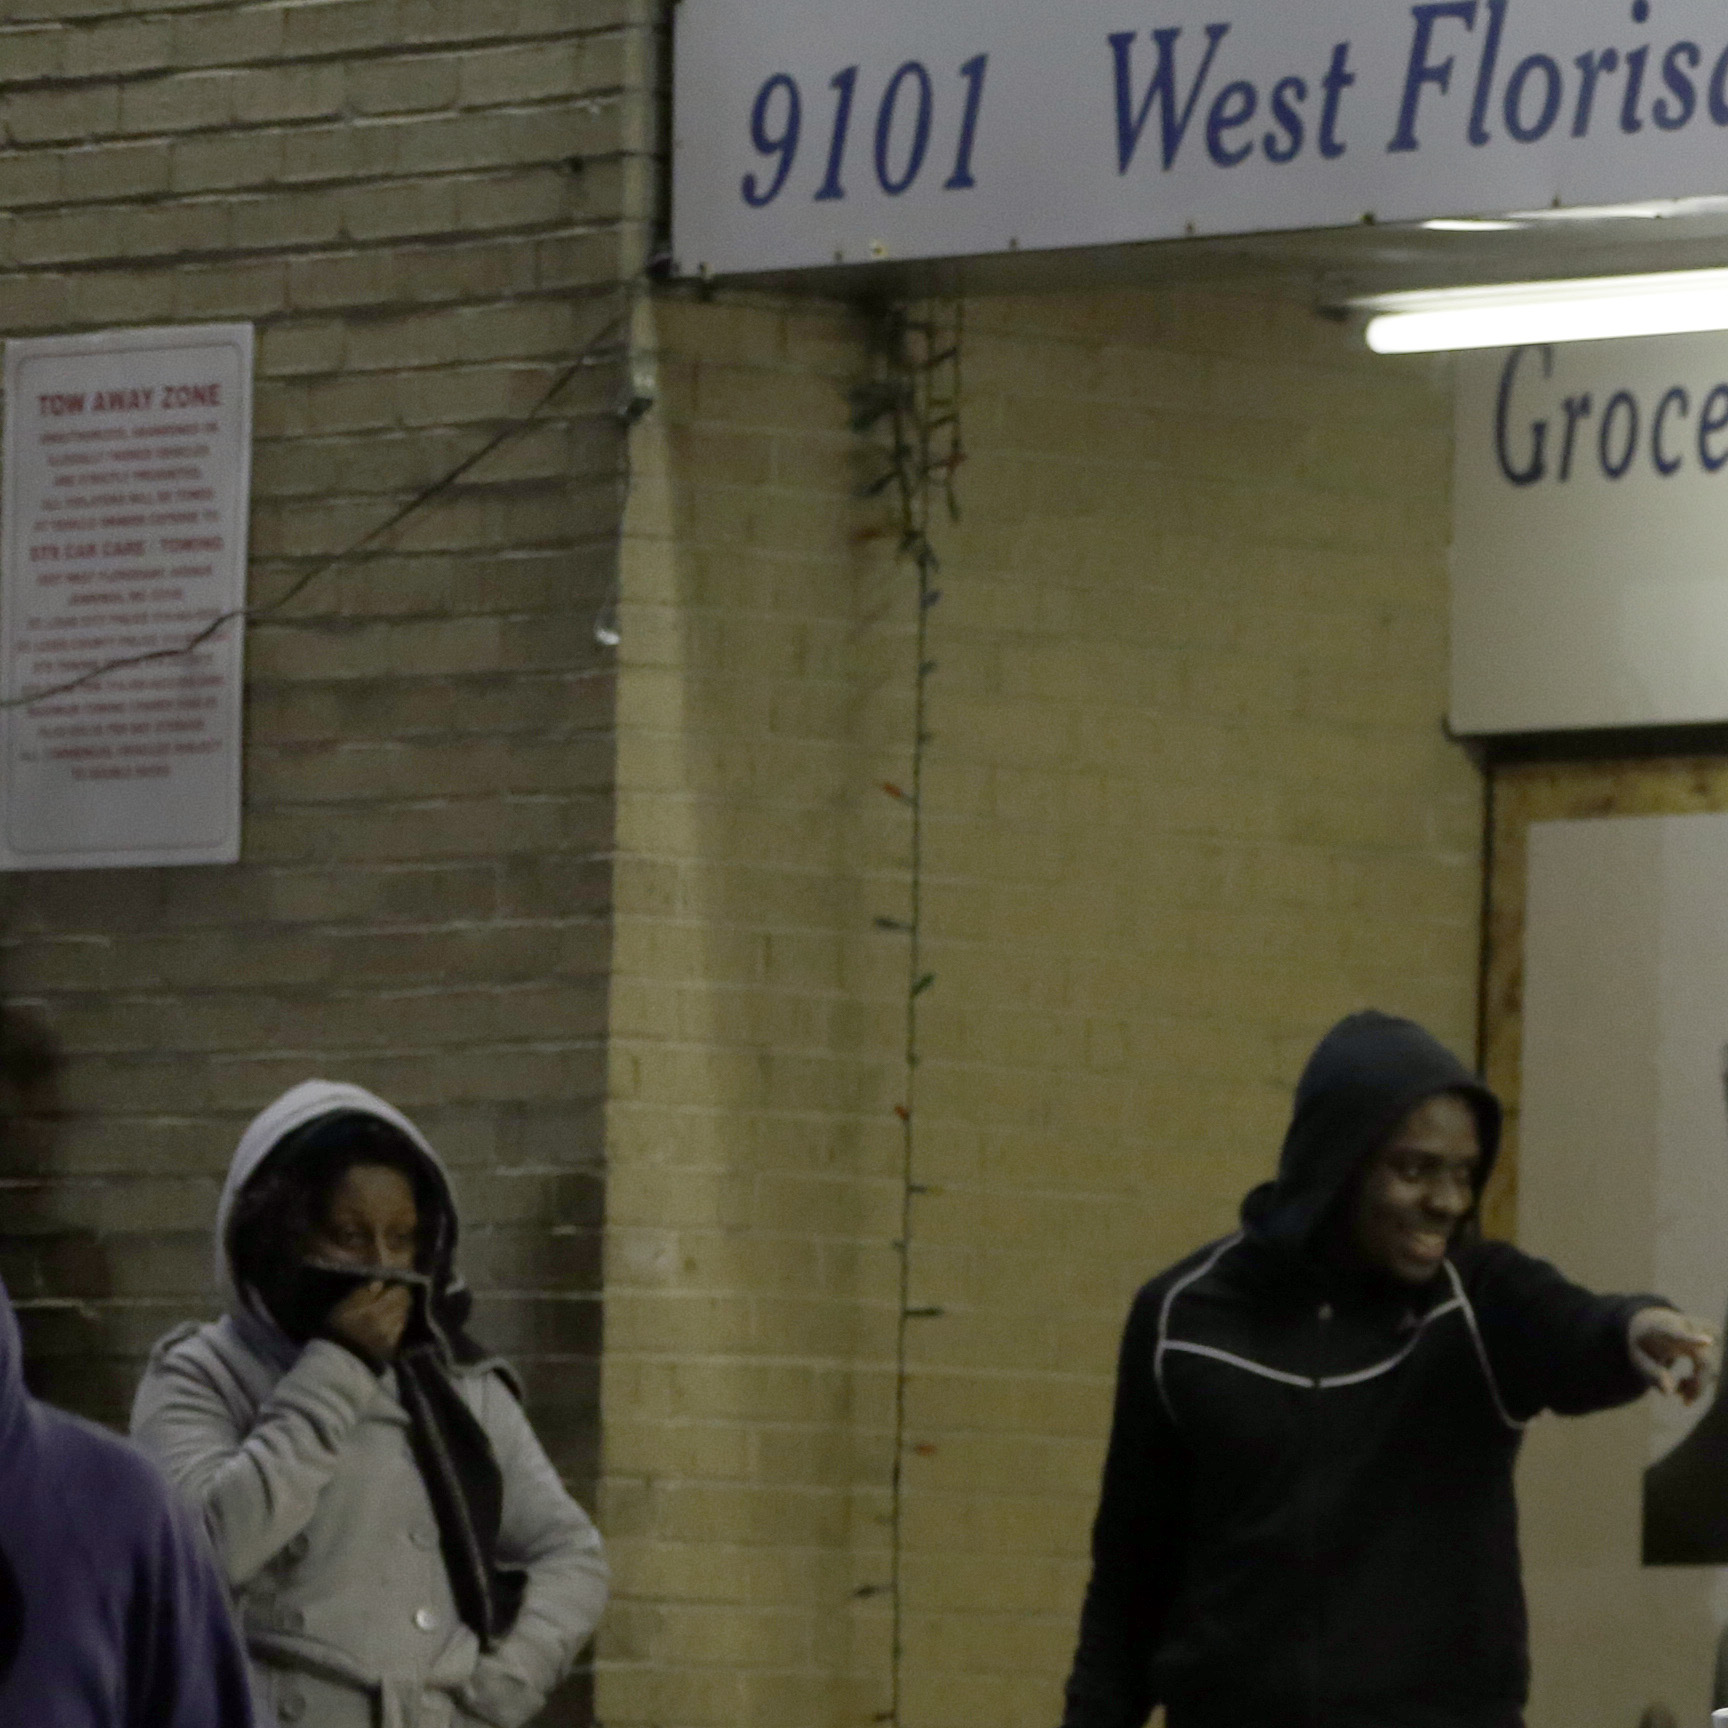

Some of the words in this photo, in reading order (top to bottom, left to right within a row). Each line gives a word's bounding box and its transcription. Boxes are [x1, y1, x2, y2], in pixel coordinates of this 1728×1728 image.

[741, 52, 991, 208] 9101
[1107, 22, 1356, 175] West
[39, 393, 85, 417] TOW
[91, 386, 154, 413] AWAY
[161, 382, 222, 410] ZONE
